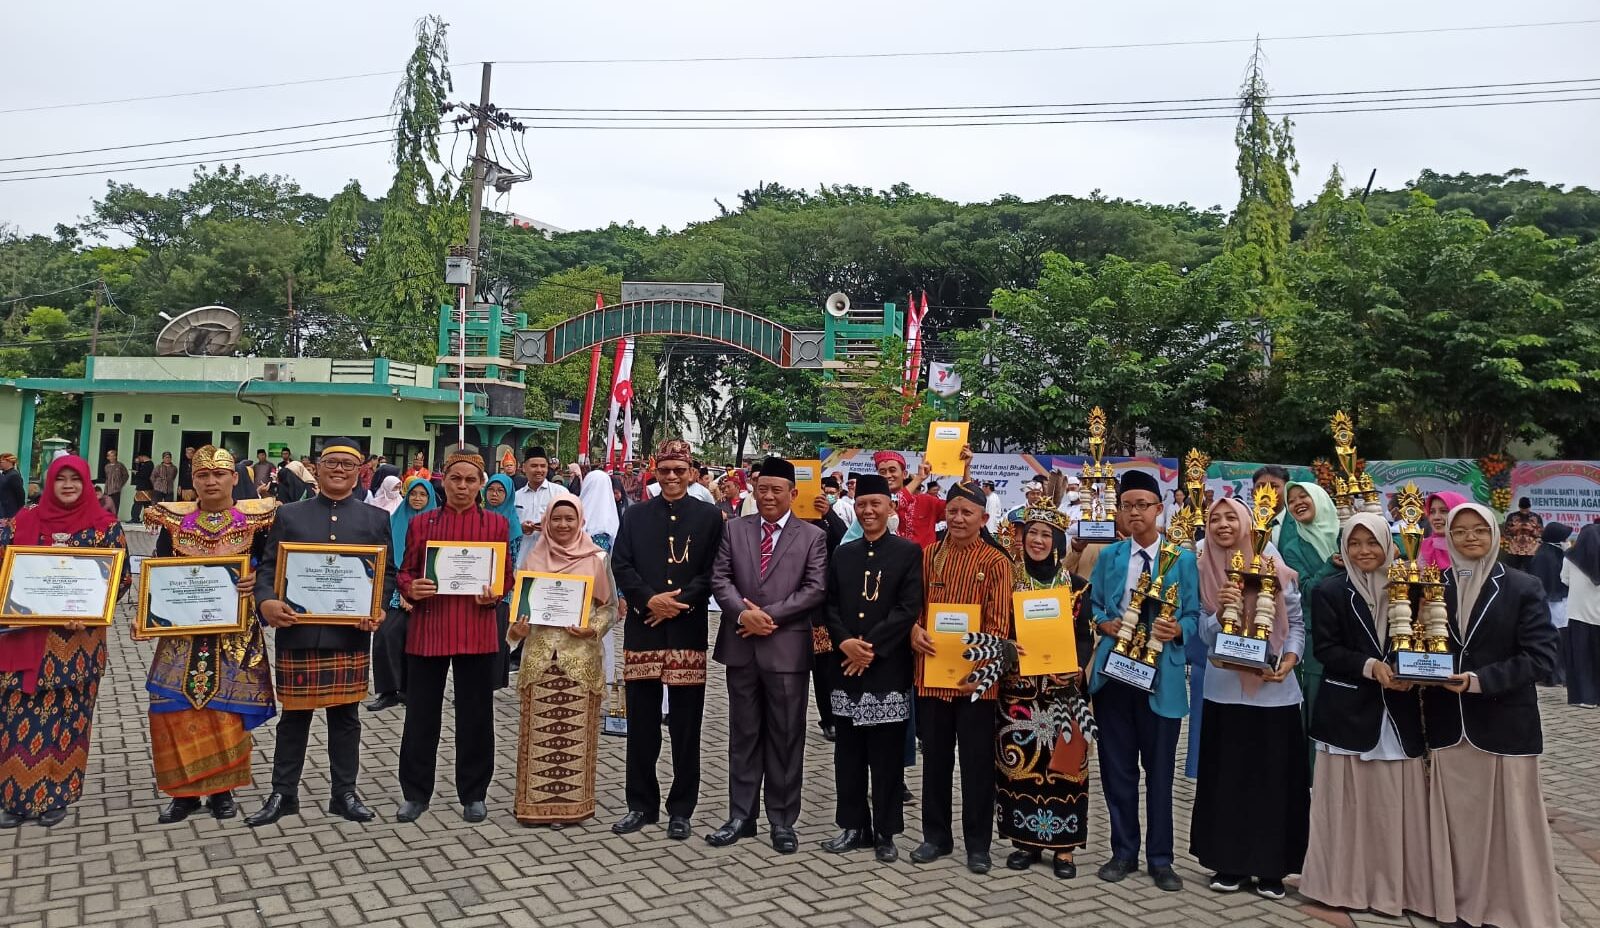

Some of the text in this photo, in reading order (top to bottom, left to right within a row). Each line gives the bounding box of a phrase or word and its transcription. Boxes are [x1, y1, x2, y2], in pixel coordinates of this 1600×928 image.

[994, 480, 1008, 488] 77
[1581, 499, 1600, 508] AGA
[1556, 513, 1580, 522] JAWA
[1222, 640, 1250, 648] JUARA
[1115, 660, 1140, 672] JUARA
